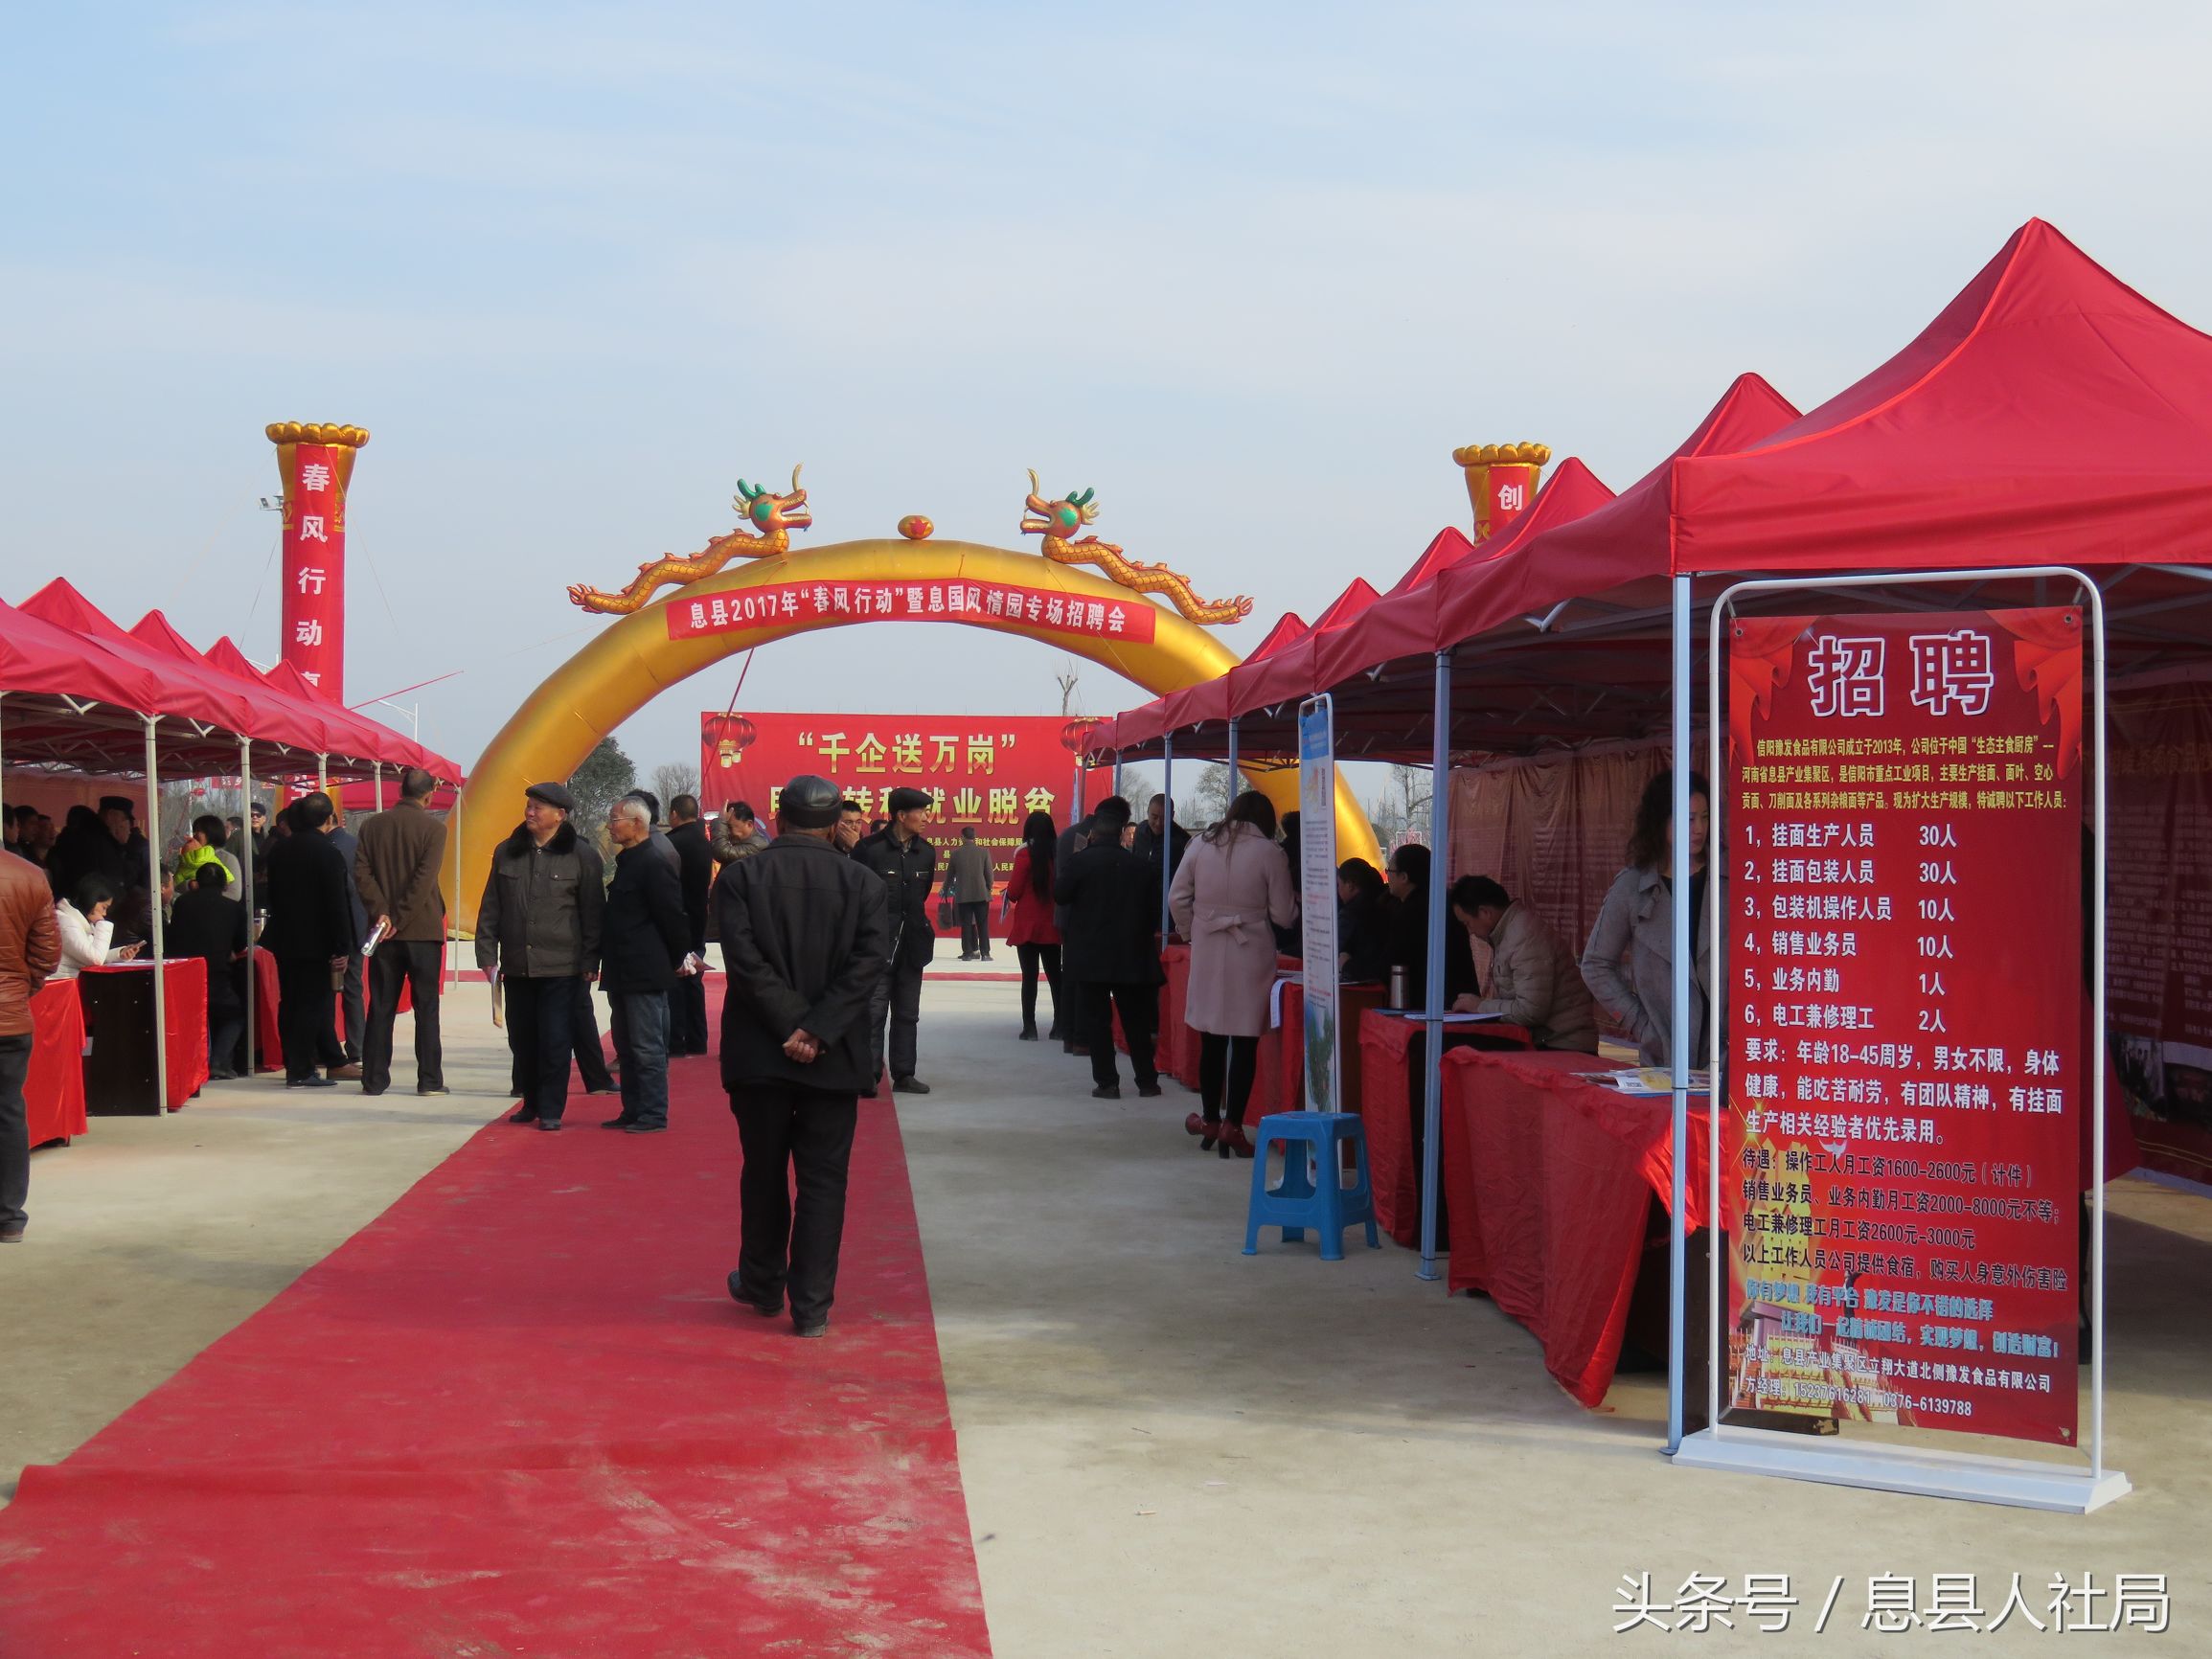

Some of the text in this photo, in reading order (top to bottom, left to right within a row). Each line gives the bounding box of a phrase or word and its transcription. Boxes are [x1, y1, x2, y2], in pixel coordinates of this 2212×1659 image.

[1497, 484, 1523, 511] 创
[1807, 629, 1994, 717] 招聘
[798, 731, 1016, 775] “千企送万岗”
[1918, 823, 1957, 848] 30人
[1918, 860, 1957, 885] 30人
[1918, 898, 1955, 922] 10人
[1917, 934, 1953, 959] 10人
[1918, 971, 1946, 996] 1人
[1918, 1009, 1947, 1034] 2人
[1745, 1110, 1945, 1145] 生产相关经验者优先录用。
